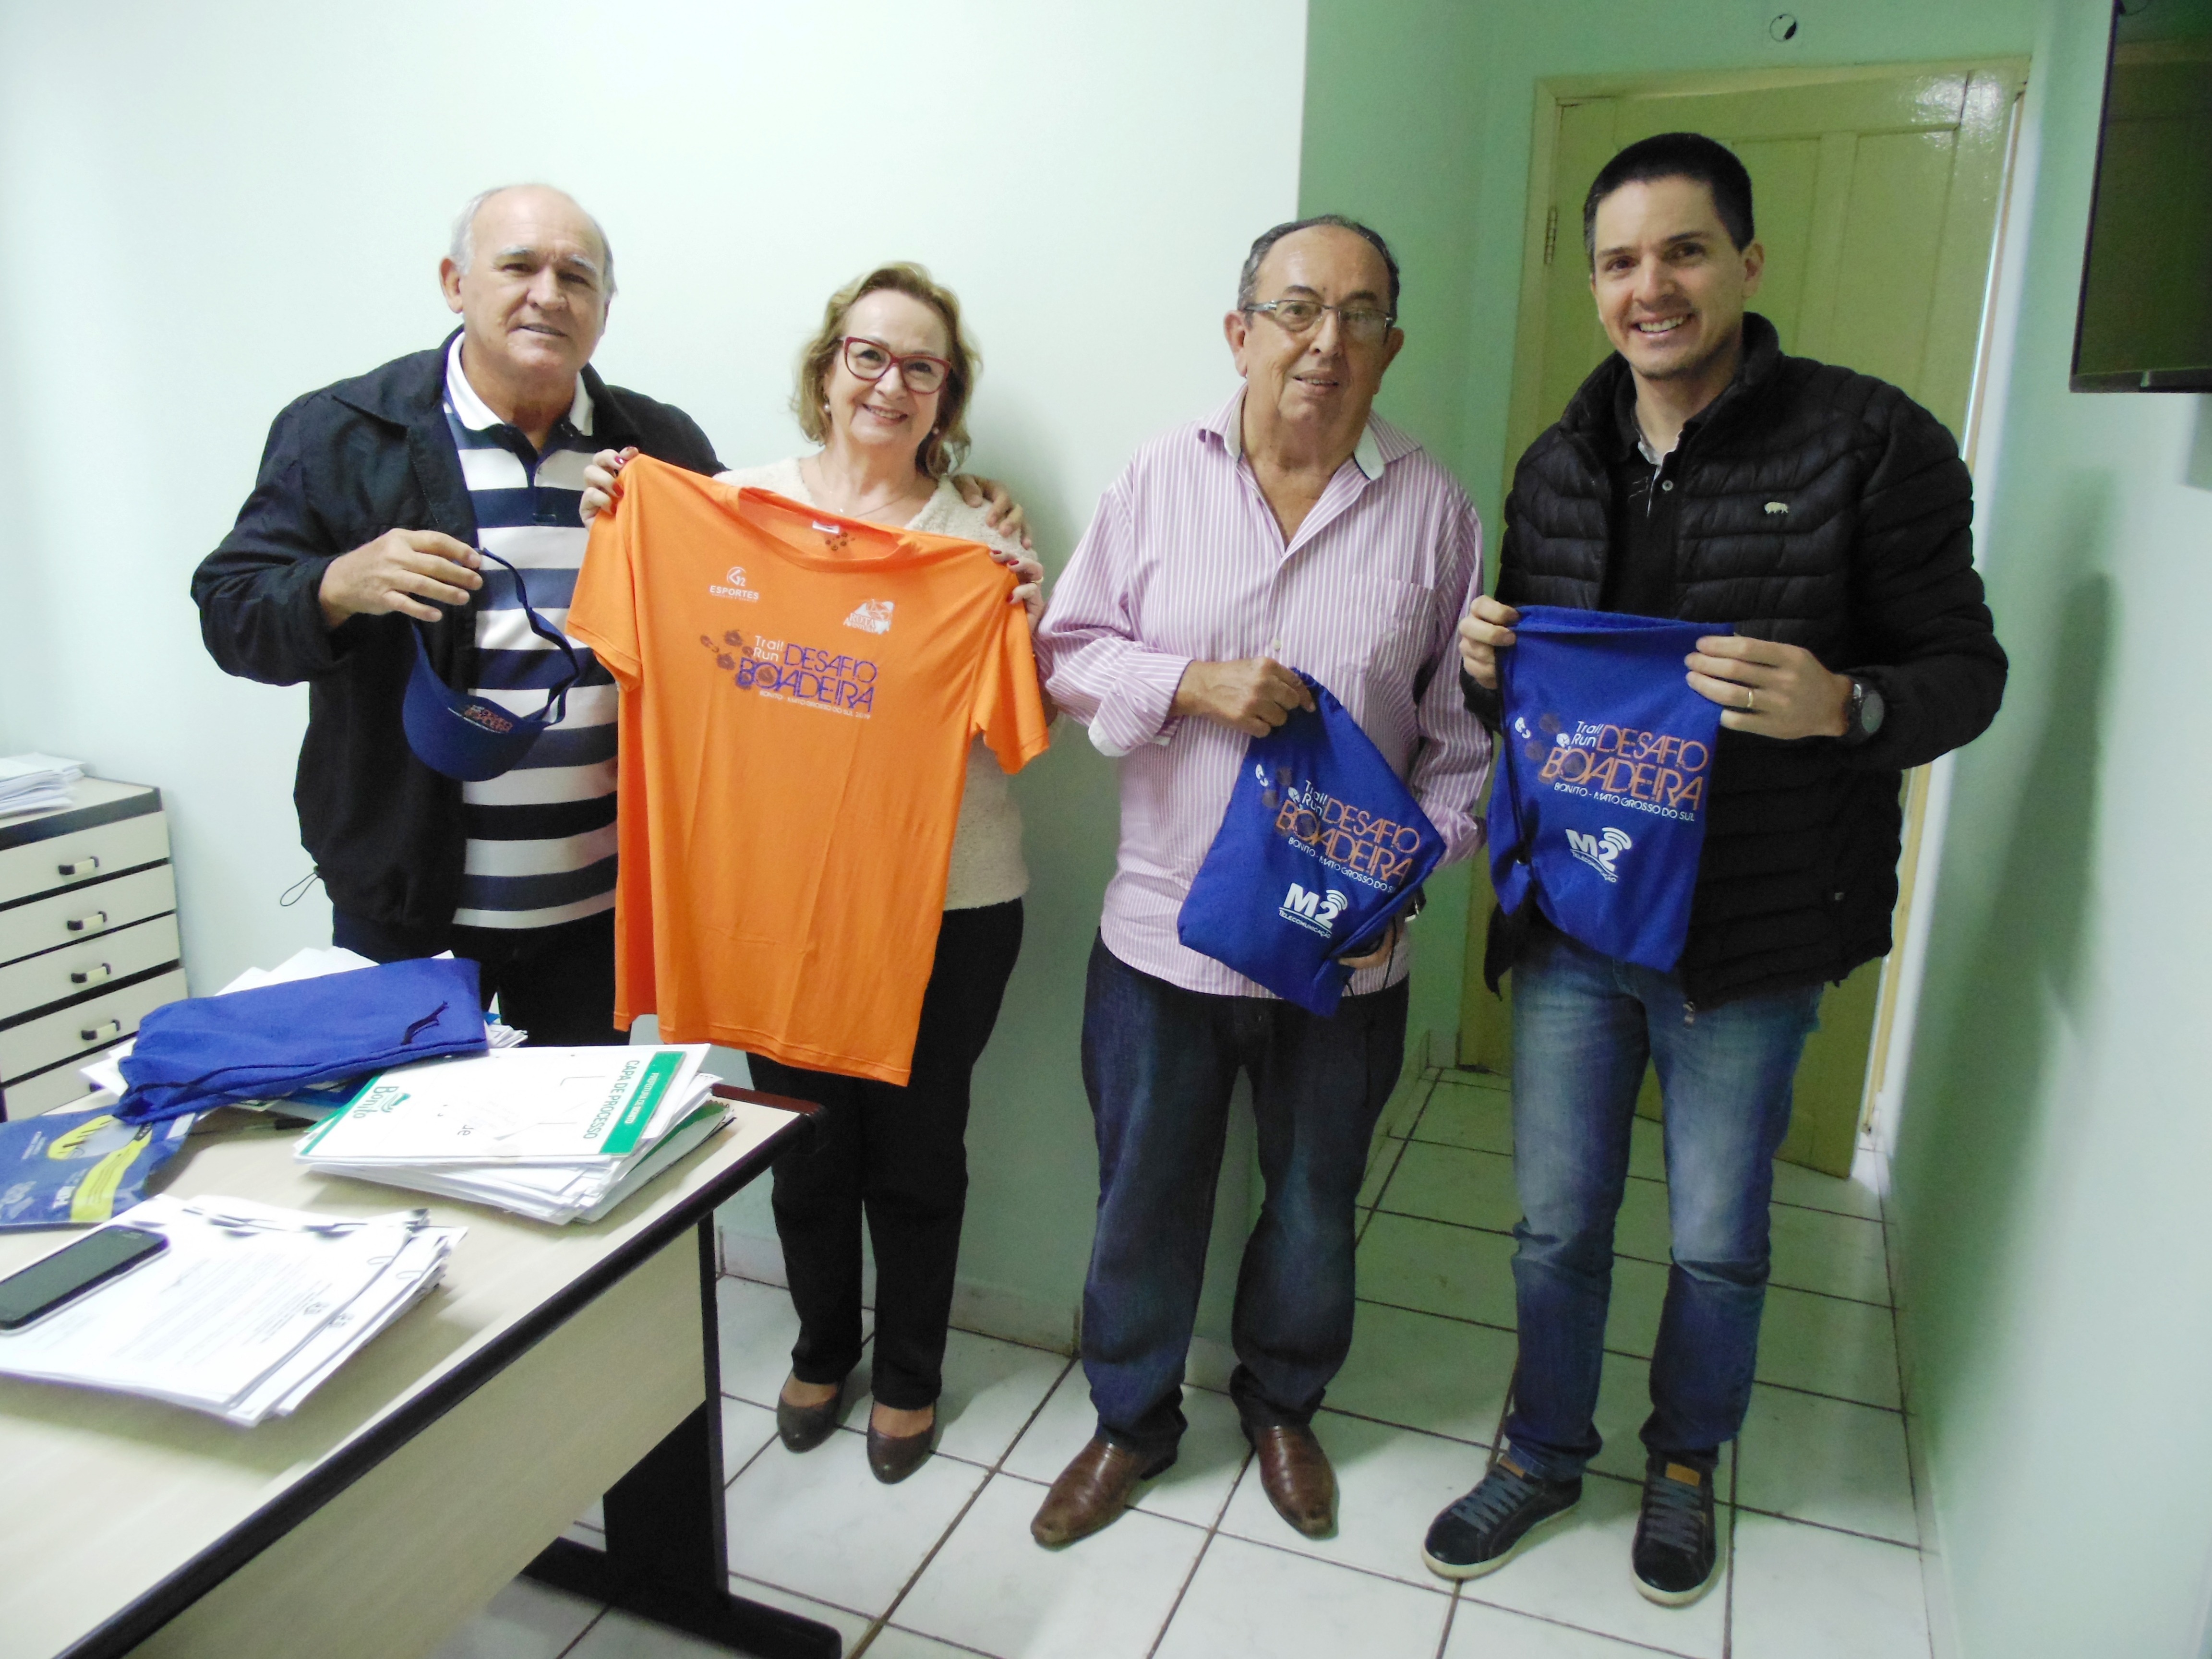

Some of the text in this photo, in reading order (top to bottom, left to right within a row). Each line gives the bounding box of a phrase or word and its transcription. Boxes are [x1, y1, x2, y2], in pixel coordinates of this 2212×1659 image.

[709, 585, 759, 600] ESPORTES
[849, 613, 876, 628] ROTA
[753, 648, 779, 661] Run
[755, 636, 785, 652] Trail
[784, 643, 878, 683] DESAFIO
[738, 657, 875, 712] BOIADEIRA
[759, 690, 783, 700] BONITO
[1571, 733, 1597, 747] Run
[1576, 721, 1604, 735] Trail
[1596, 724, 1709, 772] DESAFIO
[1304, 780, 1328, 805] Trail
[1540, 747, 1704, 810] BOIADEIRA
[1302, 793, 1323, 816] Run
[1554, 782, 1588, 797] BONITO
[1593, 791, 1620, 805] MATO
[1621, 797, 1661, 815] GROSSO
[1661, 806, 1678, 819] DO
[1679, 811, 1695, 821] SUL
[1275, 799, 1413, 885] BOIADEIRA
[1322, 798, 1420, 854] DESAFIO
[1288, 837, 1316, 856] BONITO
[1319, 856, 1341, 871] MATO
[1341, 867, 1373, 885] GROSSO
[1373, 880, 1387, 890] DO
[1565, 829, 1619, 872] M2
[1283, 882, 1339, 929] M2
[352, 1086, 399, 1118] Bonito
[583, 1060, 640, 1139] CAPA DE PROCESSO
